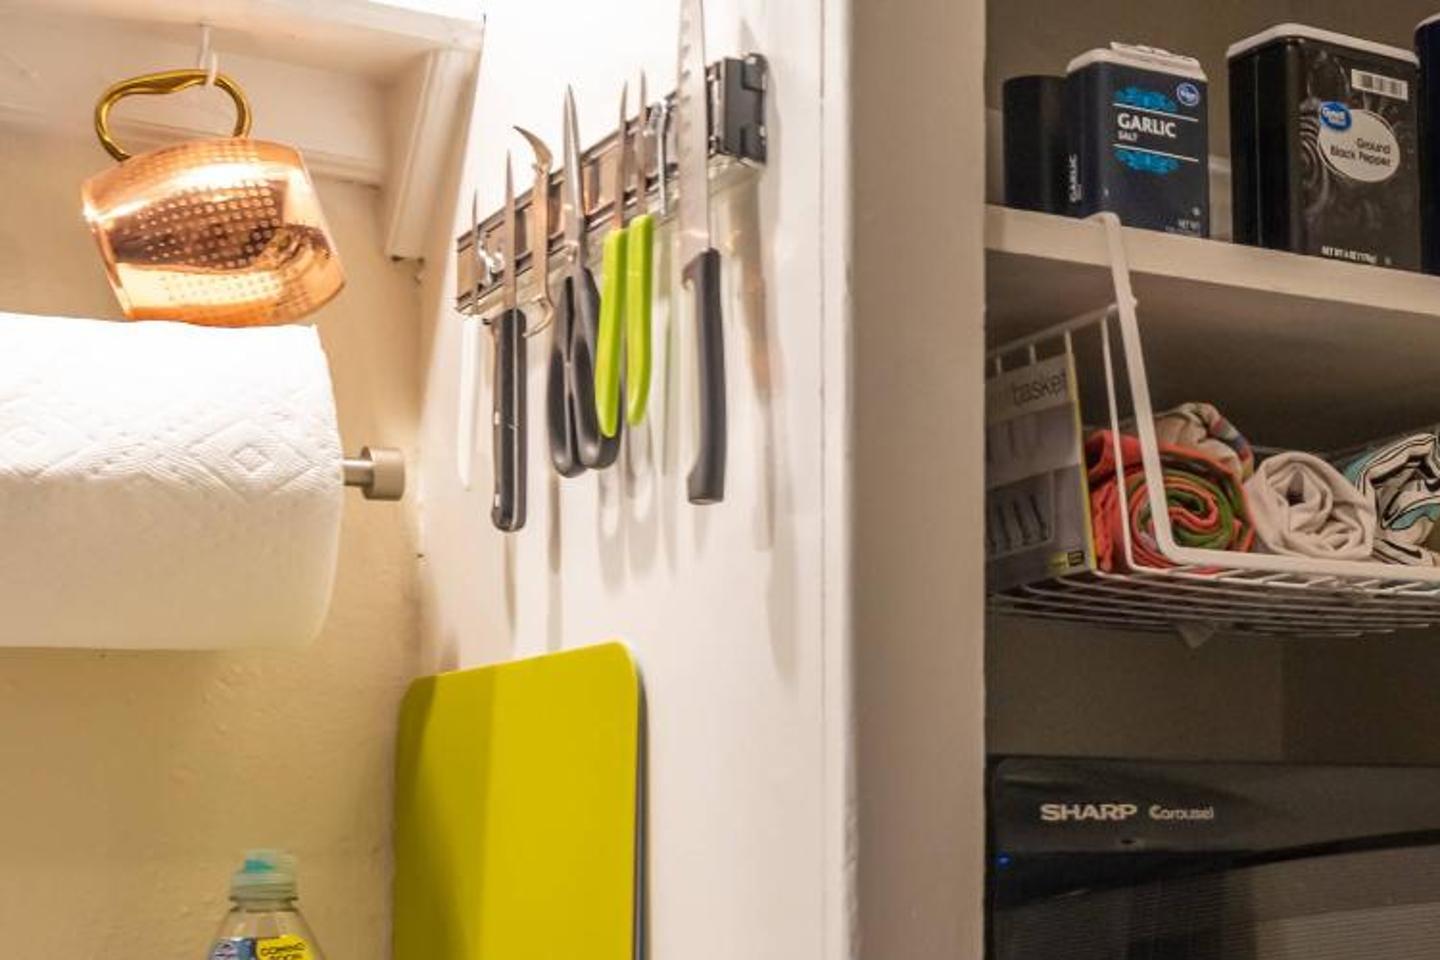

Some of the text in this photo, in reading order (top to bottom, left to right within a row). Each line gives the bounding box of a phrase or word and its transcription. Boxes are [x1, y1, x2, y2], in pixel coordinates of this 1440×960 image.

[1117, 112, 1177, 138] GARLIC
[1330, 145, 1391, 167] Black Pepper
[1010, 370, 1066, 406] taske
[1040, 803, 1215, 821] SHARP Carousel
